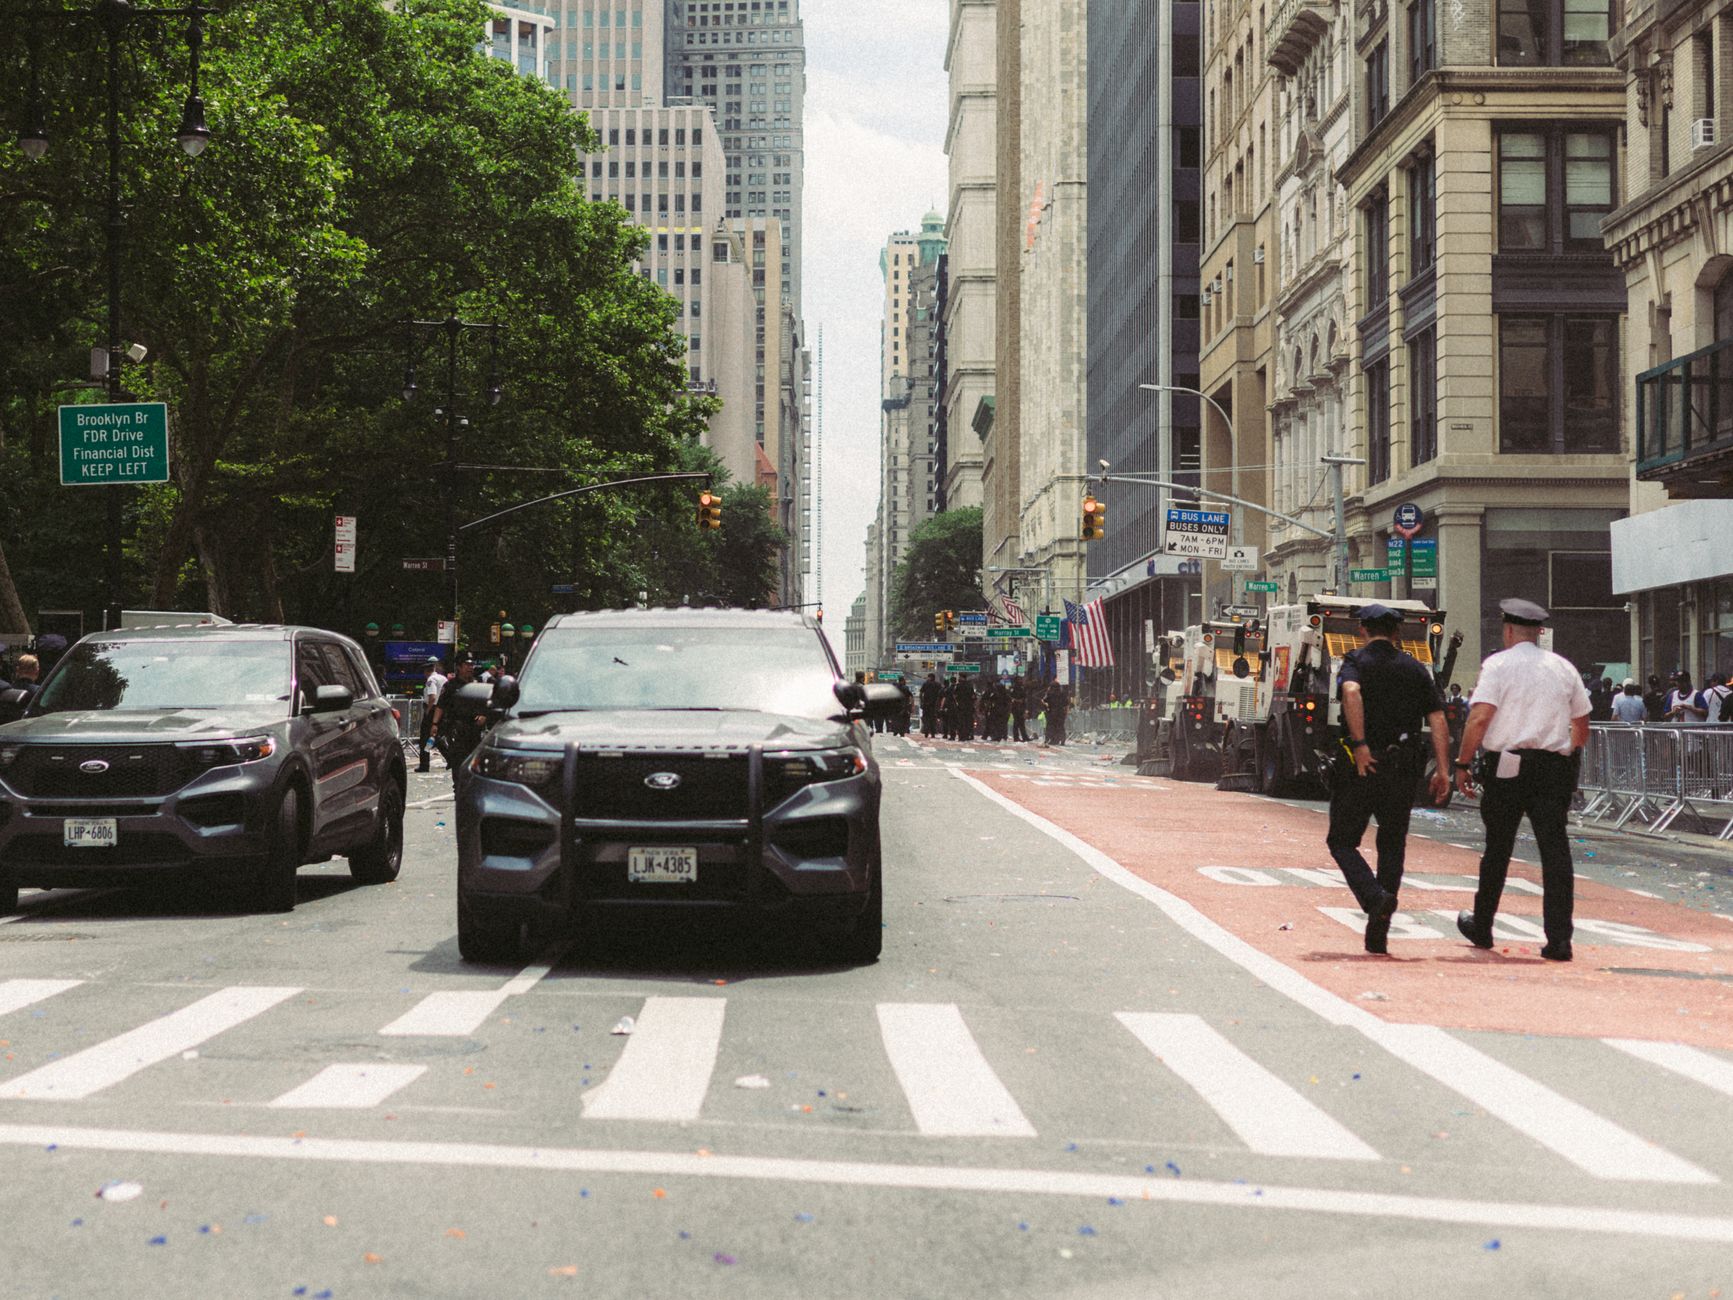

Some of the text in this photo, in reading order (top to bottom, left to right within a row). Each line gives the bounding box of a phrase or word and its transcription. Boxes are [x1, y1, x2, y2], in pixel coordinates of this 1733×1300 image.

[77, 411, 149, 428] Brooklyn Br
[83, 429, 144, 442] FDR Drive
[73, 445, 154, 460] Financial Dist
[82, 462, 147, 476] KEEP LEFT
[1181, 511, 1225, 523] BUS LANE
[1169, 521, 1225, 534] BUSES ONLY
[1180, 534, 1198, 543] 7AM
[1205, 537, 1224, 546] 6PM
[1180, 545, 1199, 553] MON
[1208, 546, 1223, 555] FRI
[1353, 572, 1380, 580] Warren
[1248, 582, 1268, 590] Warren
